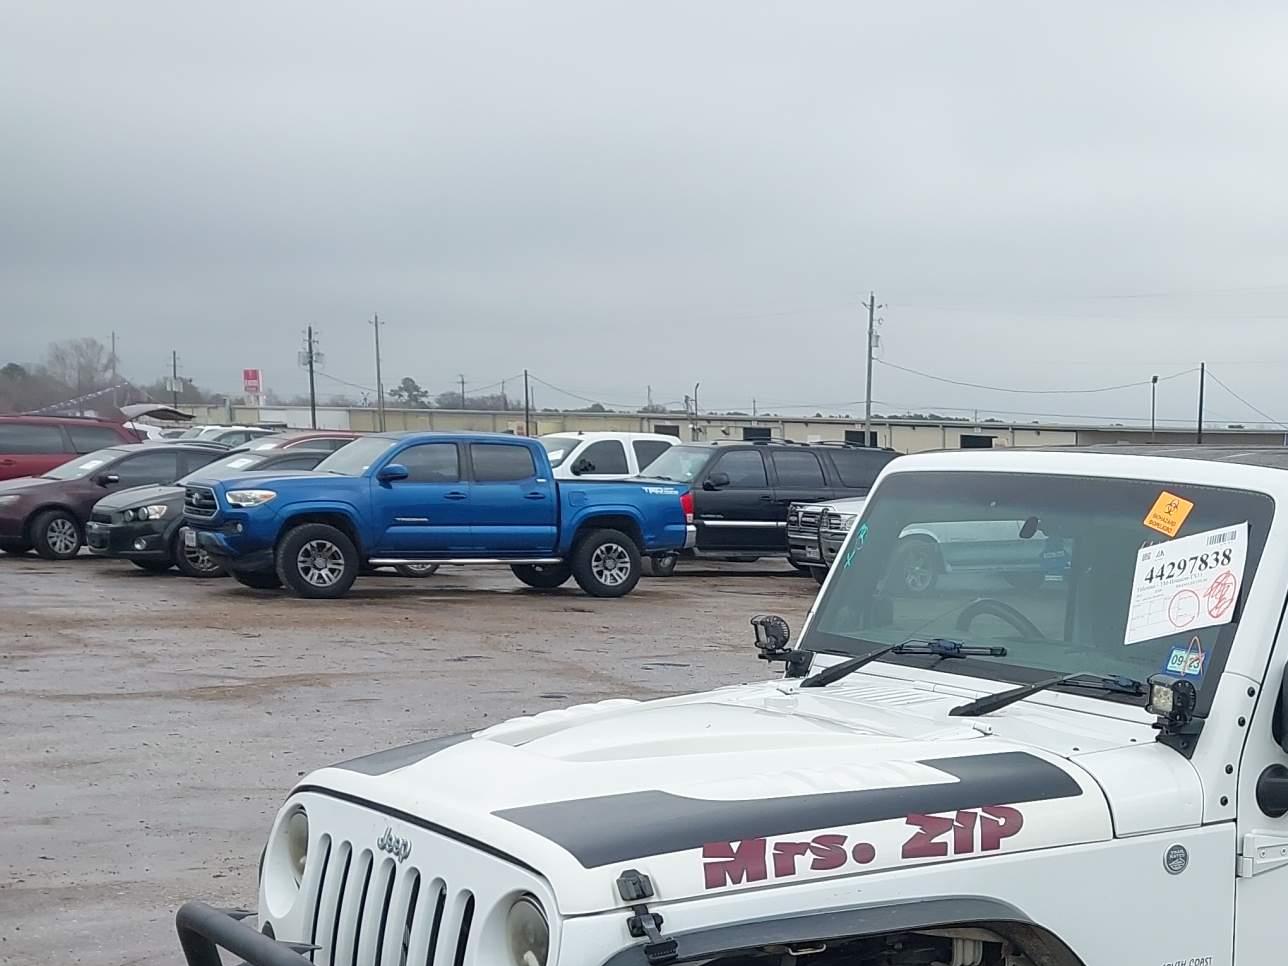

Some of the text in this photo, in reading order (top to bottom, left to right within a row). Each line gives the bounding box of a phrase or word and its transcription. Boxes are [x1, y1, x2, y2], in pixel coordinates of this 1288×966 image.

[1144, 548, 1232, 584] 44297838
[1171, 654, 1184, 666] 09
[377, 827, 412, 864] Jeep
[701, 827, 877, 891] Mrs.
